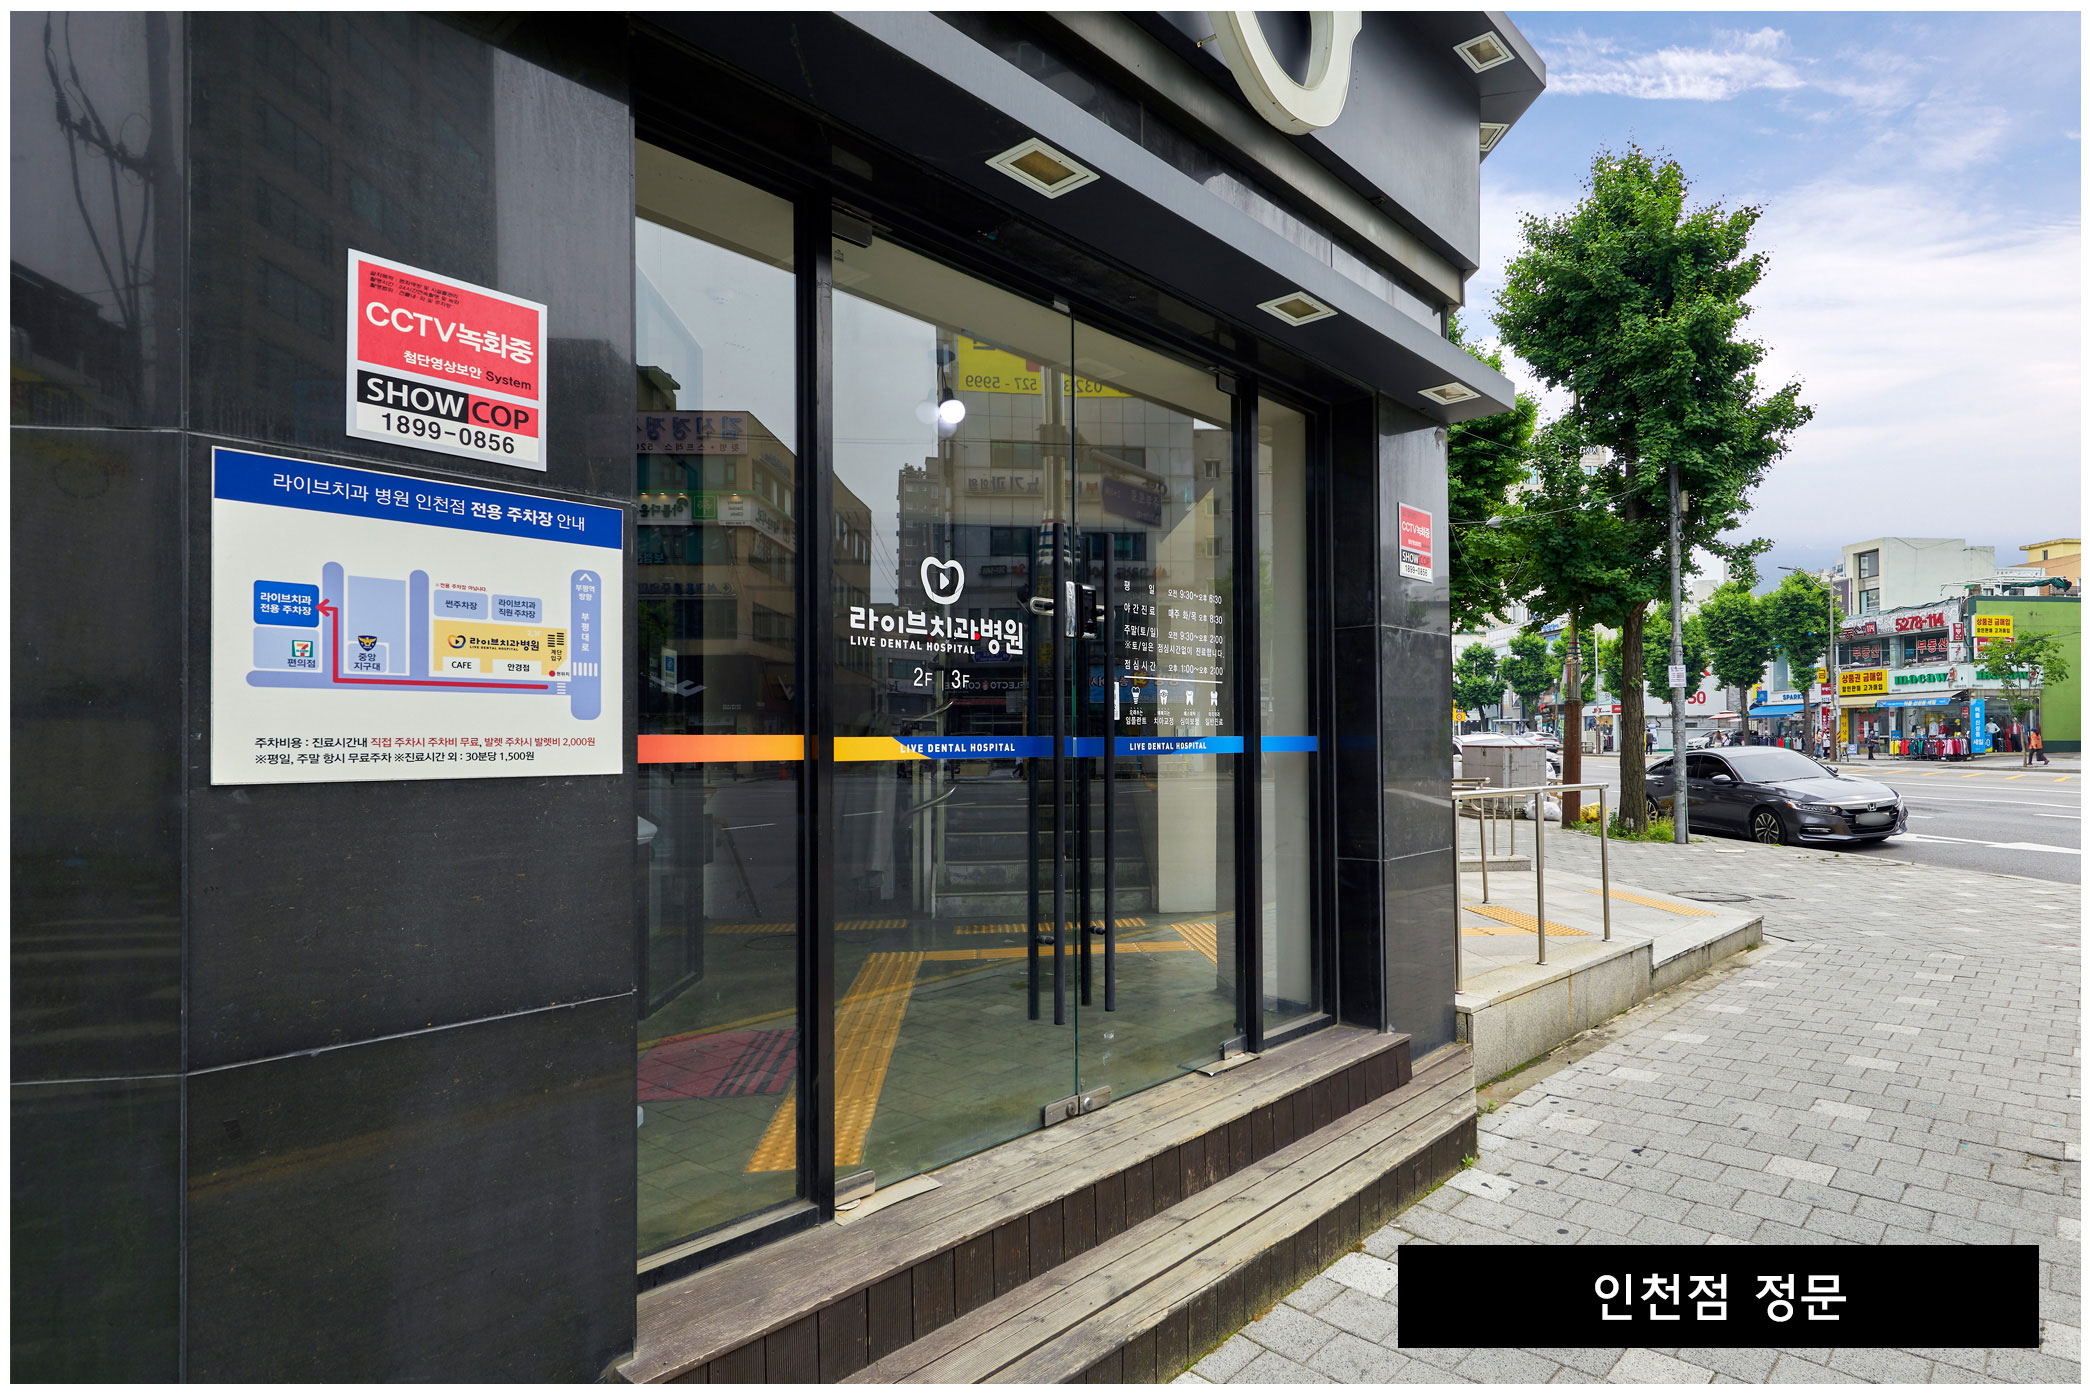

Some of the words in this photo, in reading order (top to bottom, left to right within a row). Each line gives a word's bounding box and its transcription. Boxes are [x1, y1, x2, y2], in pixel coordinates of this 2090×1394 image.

[366, 301, 534, 364] CCTV녹화중
[403, 350, 482, 380] 첨단영상보안
[485, 370, 532, 391] System
[366, 377, 465, 418] SHOW
[471, 401, 530, 430] COP
[381, 412, 515, 454] 1899-0856
[273, 473, 369, 502] 라이브치과
[375, 487, 409, 506] 병원
[415, 493, 465, 516] 인천점
[470, 501, 503, 519] 전용
[507, 506, 553, 527] 주차장
[557, 513, 585, 531] 안내
[1402, 551, 1419, 566] SHOW
[260, 591, 312, 606] 라이브치과
[1168, 588, 1178, 598] 오전
[260, 603, 280, 614] 전용
[282, 605, 312, 616] 주차장
[498, 598, 536, 610] 라이브치과
[498, 608, 513, 617] 직원
[514, 609, 536, 619] 주차장
[1168, 609, 1180, 620] 매주
[1209, 614, 1223, 625] 8:30
[1895, 612, 1945, 632] 5278-114
[1976, 618, 1993, 626] 상품권
[1994, 618, 2011, 626] 금매입
[850, 606, 1024, 655] 라이브치과병원
[1124, 624, 1159, 638] 주말(토/일)
[1168, 631, 1178, 640] 오전
[469, 636, 540, 652] 라이브치과병원
[850, 635, 876, 647] LIVE
[880, 638, 923, 651] DENTAL
[927, 641, 975, 655] HOSPITAL
[1157, 643, 1193, 655] 점심시간없이
[1917, 637, 1948, 654] 부동산
[358, 653, 376, 662] 중앙
[1853, 644, 1880, 660] 부동산
[287, 658, 316, 668] 편의점
[354, 662, 381, 671] 지구대
[451, 660, 472, 670] CAFE
[507, 663, 530, 672] 안경점
[1124, 659, 1156, 672] 점심시간
[913, 667, 933, 687] 2F
[951, 669, 970, 689] 3F
[1818, 669, 1826, 679] 금
[1841, 672, 1861, 684] 상품권
[1862, 671, 1883, 683] 금매입
[1894, 672, 1949, 685] macaw
[254, 737, 302, 748] 주차비용
[312, 737, 368, 748] 진료시간내
[370, 737, 392, 748] 직접
[394, 737, 426, 748] 주차시
[428, 737, 457, 748] 주차비
[460, 737, 482, 748] 무료,
[484, 737, 503, 747] 발렛
[505, 737, 532, 747] 주차시
[534, 737, 561, 747] 발렛비
[562, 737, 596, 747] 2,000원
[900, 743, 923, 753] LIVE
[927, 743, 967, 753] DENTAL
[970, 743, 1016, 752] HOSPITAL
[1129, 742, 1146, 751] LIVE
[1148, 742, 1174, 751] DENTAL
[1176, 741, 1207, 750] HOSPITAL
[297, 753, 320, 764] 주말
[323, 752, 345, 764] 항시
[348, 752, 392, 763] 무료주차
[447, 752, 457, 762] 외
[465, 752, 497, 762] 30분당
[499, 751, 535, 762] 1,500원
